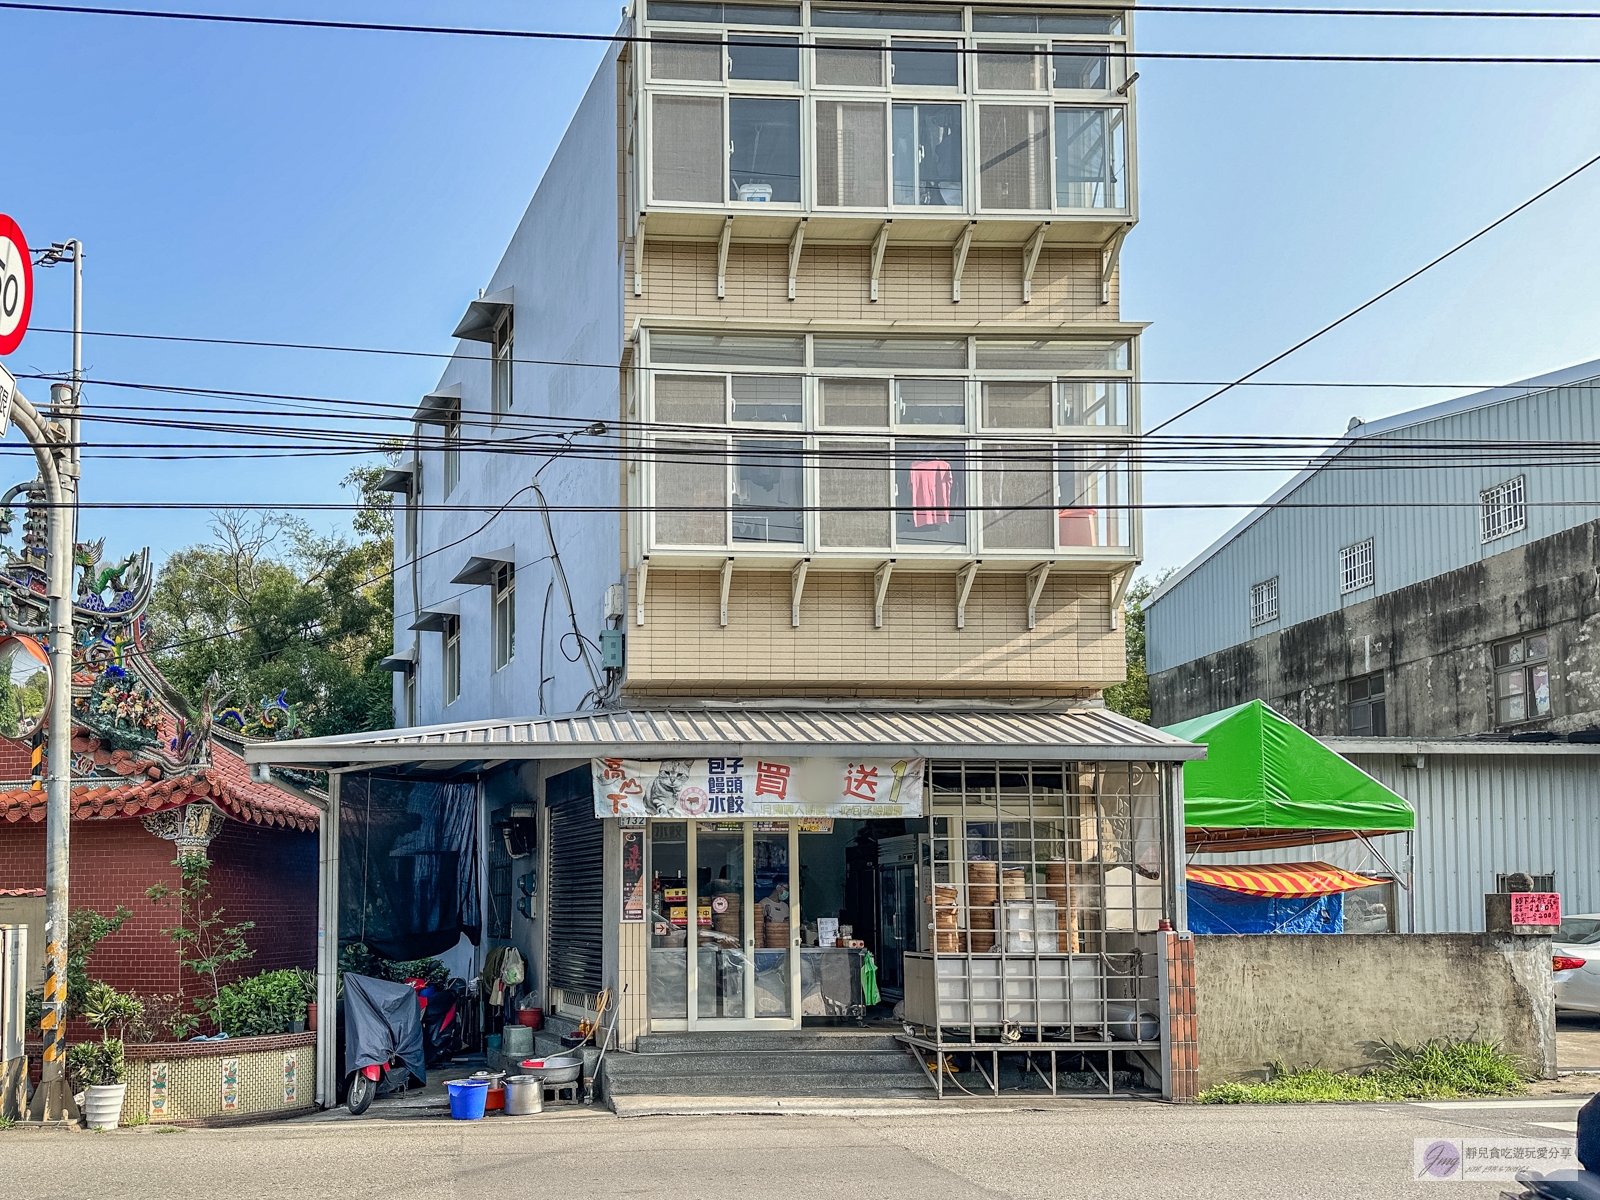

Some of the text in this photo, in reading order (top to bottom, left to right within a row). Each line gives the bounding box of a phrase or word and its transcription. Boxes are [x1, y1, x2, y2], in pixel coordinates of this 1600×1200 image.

[707, 757, 744, 774] 包子
[707, 776, 743, 793] 饅頭
[755, 761, 790, 800] 買
[708, 796, 744, 813] 水餃
[626, 817, 645, 825] 132
